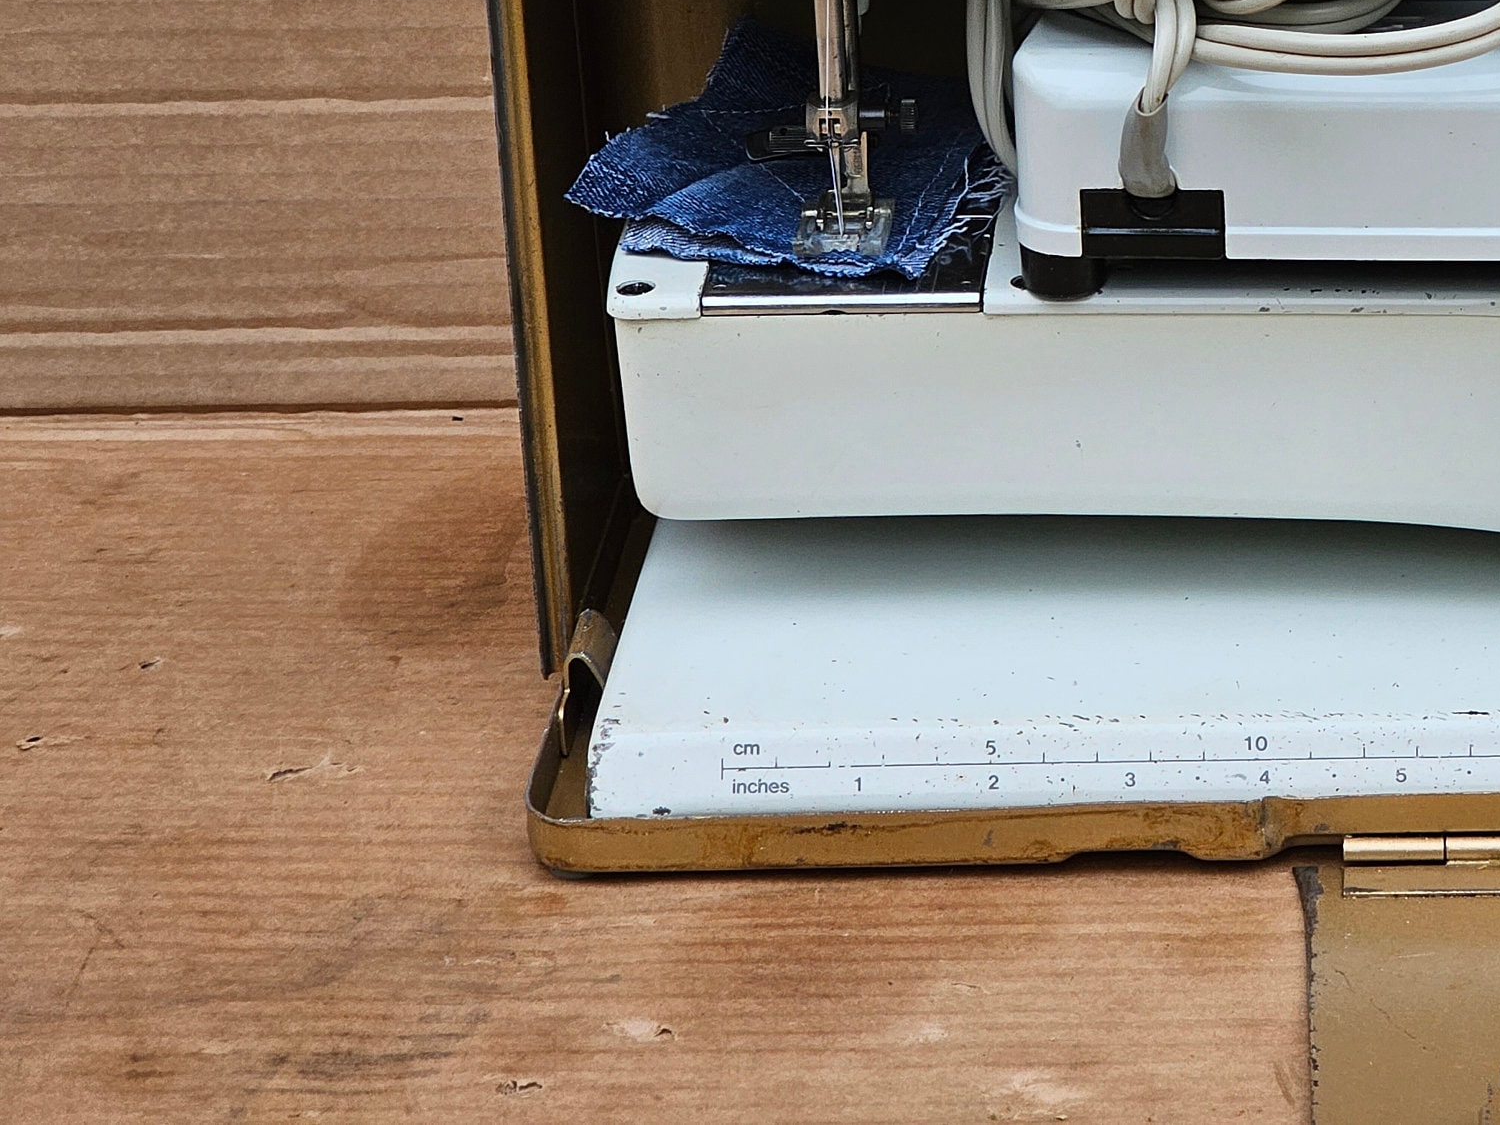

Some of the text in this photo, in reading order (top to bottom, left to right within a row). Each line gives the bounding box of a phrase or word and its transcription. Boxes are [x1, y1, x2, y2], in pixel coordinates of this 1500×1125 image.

[732, 743, 761, 756] cm
[985, 739, 997, 756] 5
[1244, 735, 1268, 752] 10
[732, 778, 790, 795] inches
[854, 776, 862, 792] 1
[988, 774, 1000, 790] 2
[1124, 771, 1136, 788] 3
[1259, 770, 1271, 785] 4
[1395, 767, 1407, 783] 5
